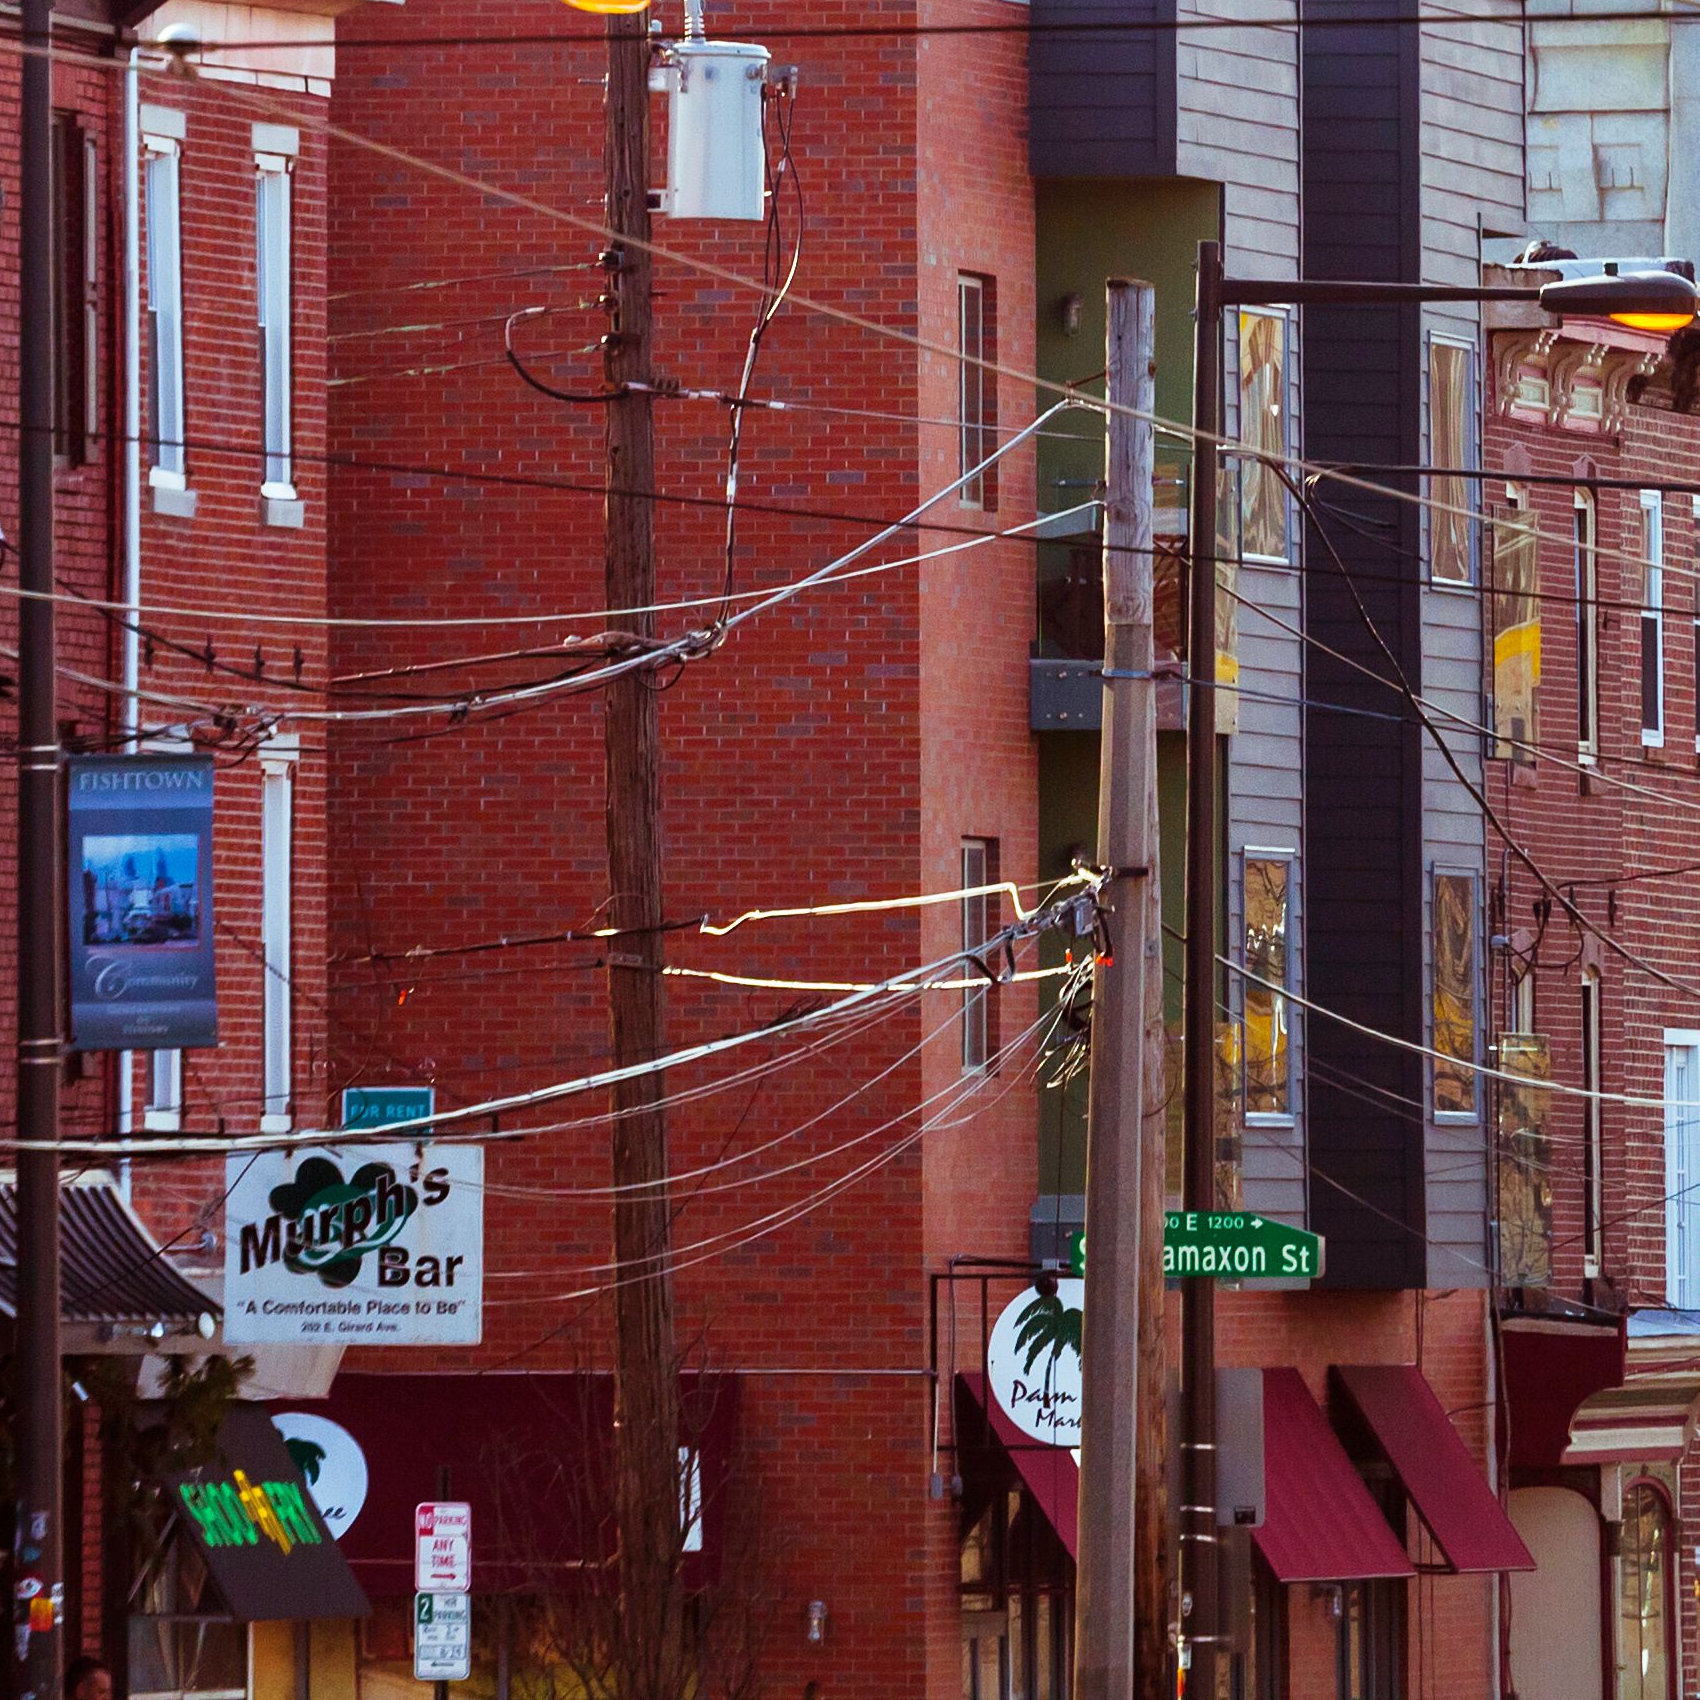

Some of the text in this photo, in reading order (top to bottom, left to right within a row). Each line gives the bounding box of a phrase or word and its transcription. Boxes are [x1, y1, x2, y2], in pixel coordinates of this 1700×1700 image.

[79, 771, 205, 791] FISHTOWN
[84, 954, 198, 999] Community
[350, 1103, 426, 1118] FOR RENT
[239, 1162, 451, 1275] Murph's
[1186, 1214, 1198, 1231] E
[1208, 1216, 1245, 1230] 1200
[377, 1246, 464, 1287] Bar
[1282, 1244, 1310, 1272] St
[262, 1300, 361, 1315] Comfortable
[366, 1300, 410, 1315] Place
[415, 1300, 431, 1314] to
[432, 1539, 454, 1551] ANY
[431, 1554, 456, 1567] TIME
[420, 1598, 430, 1620] 2
